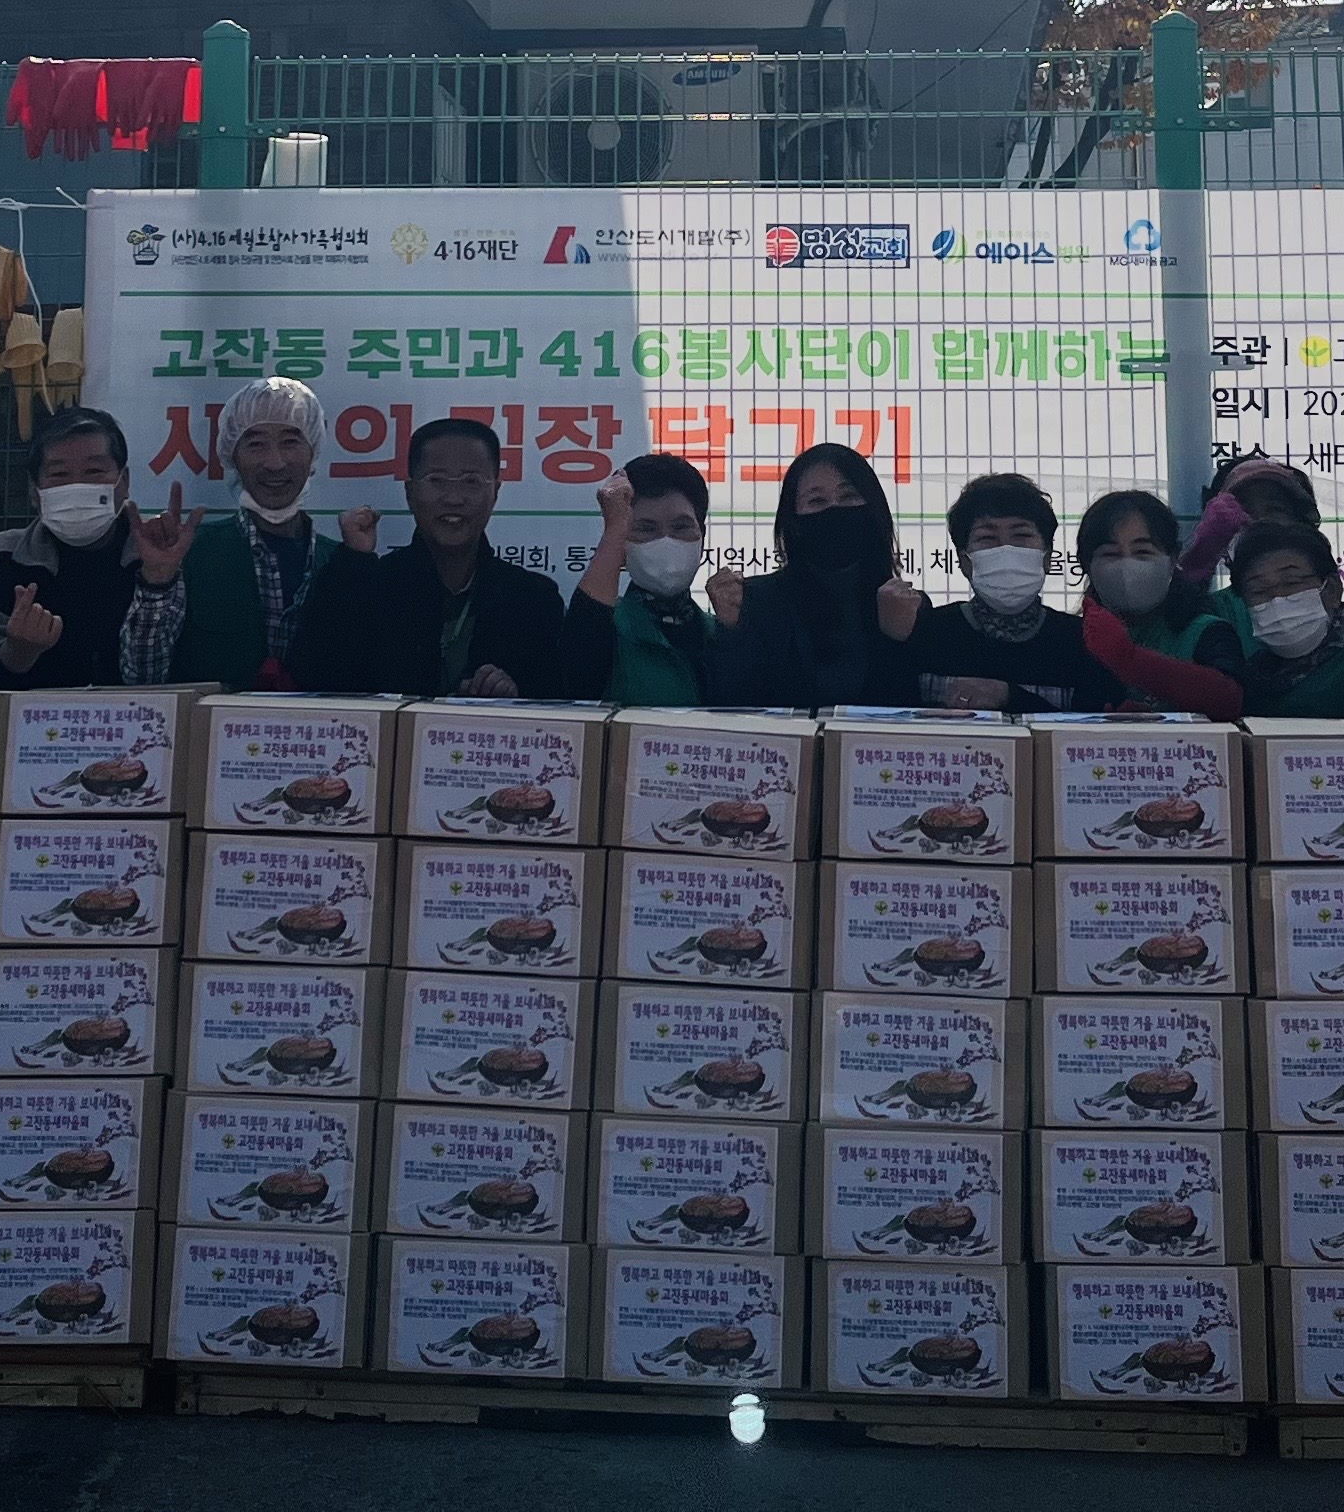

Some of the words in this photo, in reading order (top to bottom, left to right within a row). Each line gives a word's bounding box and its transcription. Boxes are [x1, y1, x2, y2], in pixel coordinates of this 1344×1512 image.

[596, 229, 752, 247] 안산도시개발(주)
[801, 227, 908, 259] 명성교회
[152, 327, 327, 379] 고잔동
[346, 327, 523, 379] 주민과
[932, 328, 1171, 382] 함께하는
[1211, 335, 1272, 366] 주관
[1212, 387, 1270, 419] 일시
[148, 404, 413, 481] 사의
[647, 404, 912, 484] 담그기
[261, 743, 326, 759] 고잔동새마을회
[894, 769, 961, 786] 고잔동새마을회
[1107, 766, 1174, 781] 고잔동새마을회
[889, 901, 957, 919] 고잔동새마을회
[881, 1033, 949, 1051] 고잔동새마을회
[879, 1167, 947, 1185] 고잔동새마을회
[883, 1299, 952, 1316] 고잔동새마을회
